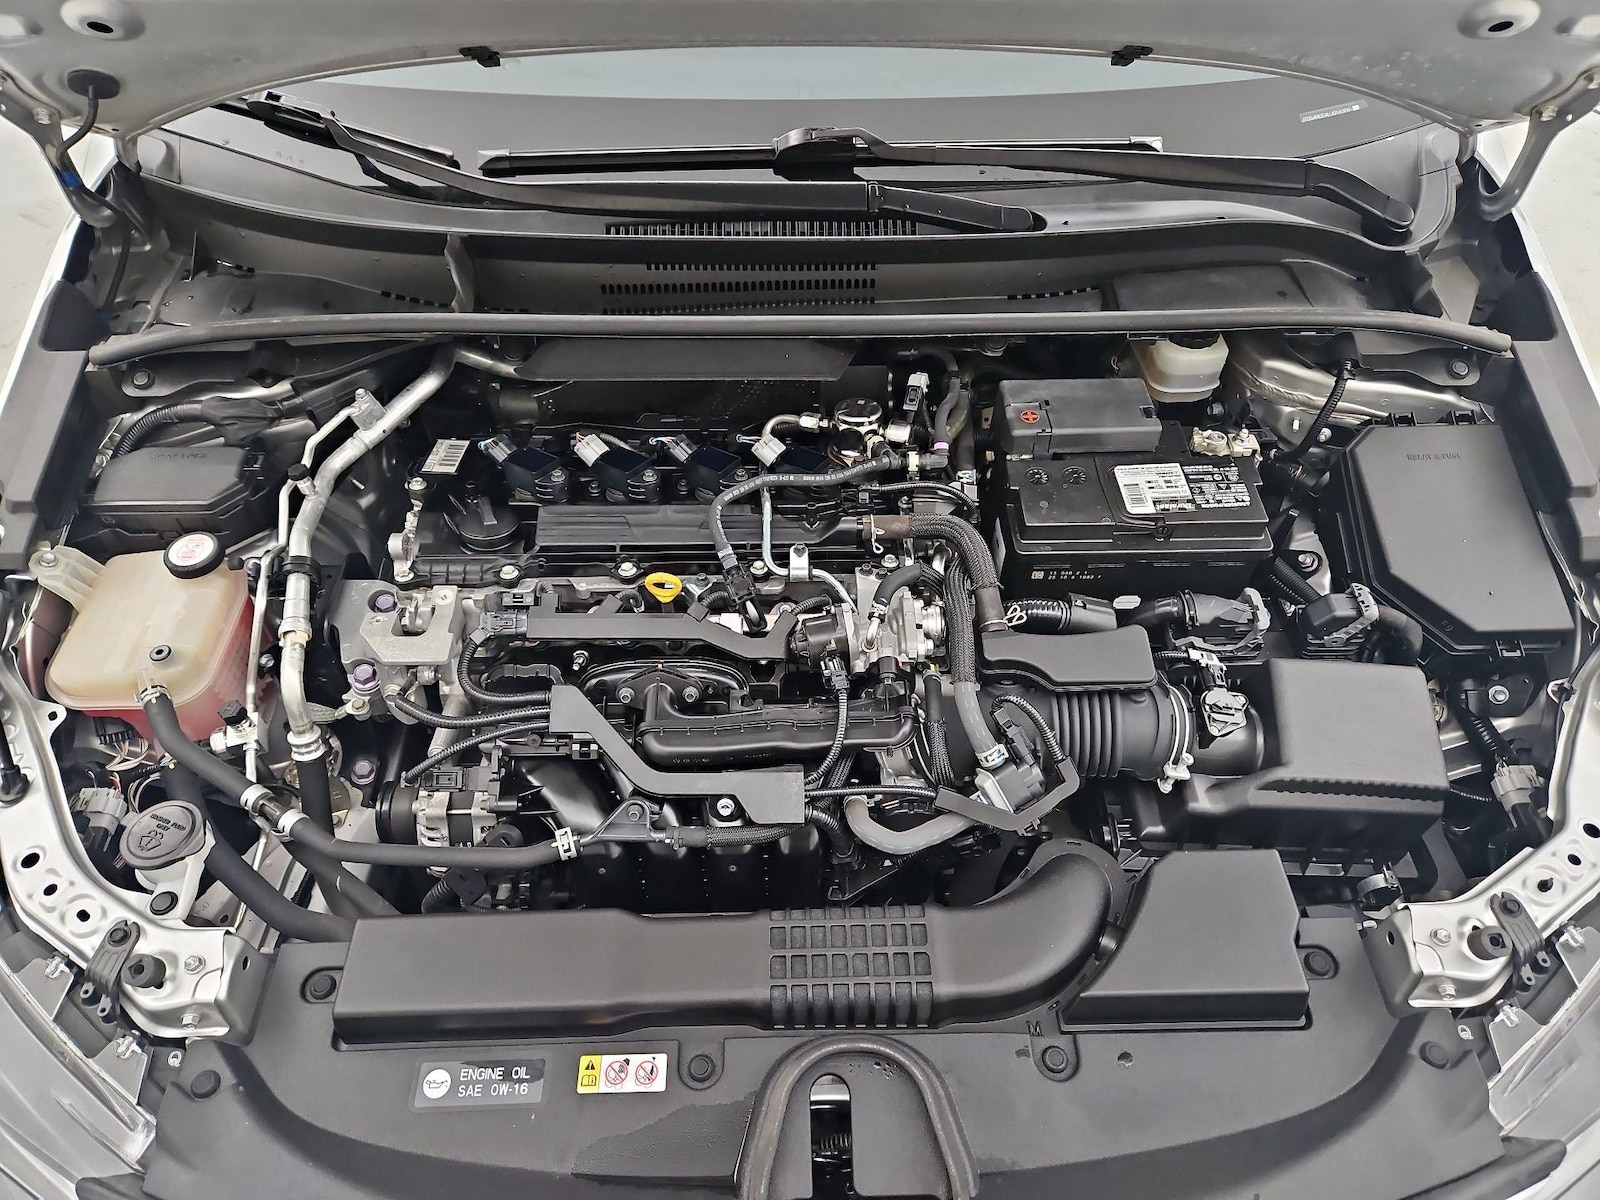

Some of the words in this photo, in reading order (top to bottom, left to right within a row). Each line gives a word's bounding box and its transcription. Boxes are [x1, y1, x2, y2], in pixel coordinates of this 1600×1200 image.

[1155, 502, 1193, 510] Duralast
[460, 1067, 504, 1080] ENGINE
[511, 1066, 531, 1079] OIL
[458, 1084, 483, 1097] SAE
[490, 1083, 528, 1096] 0W-16
